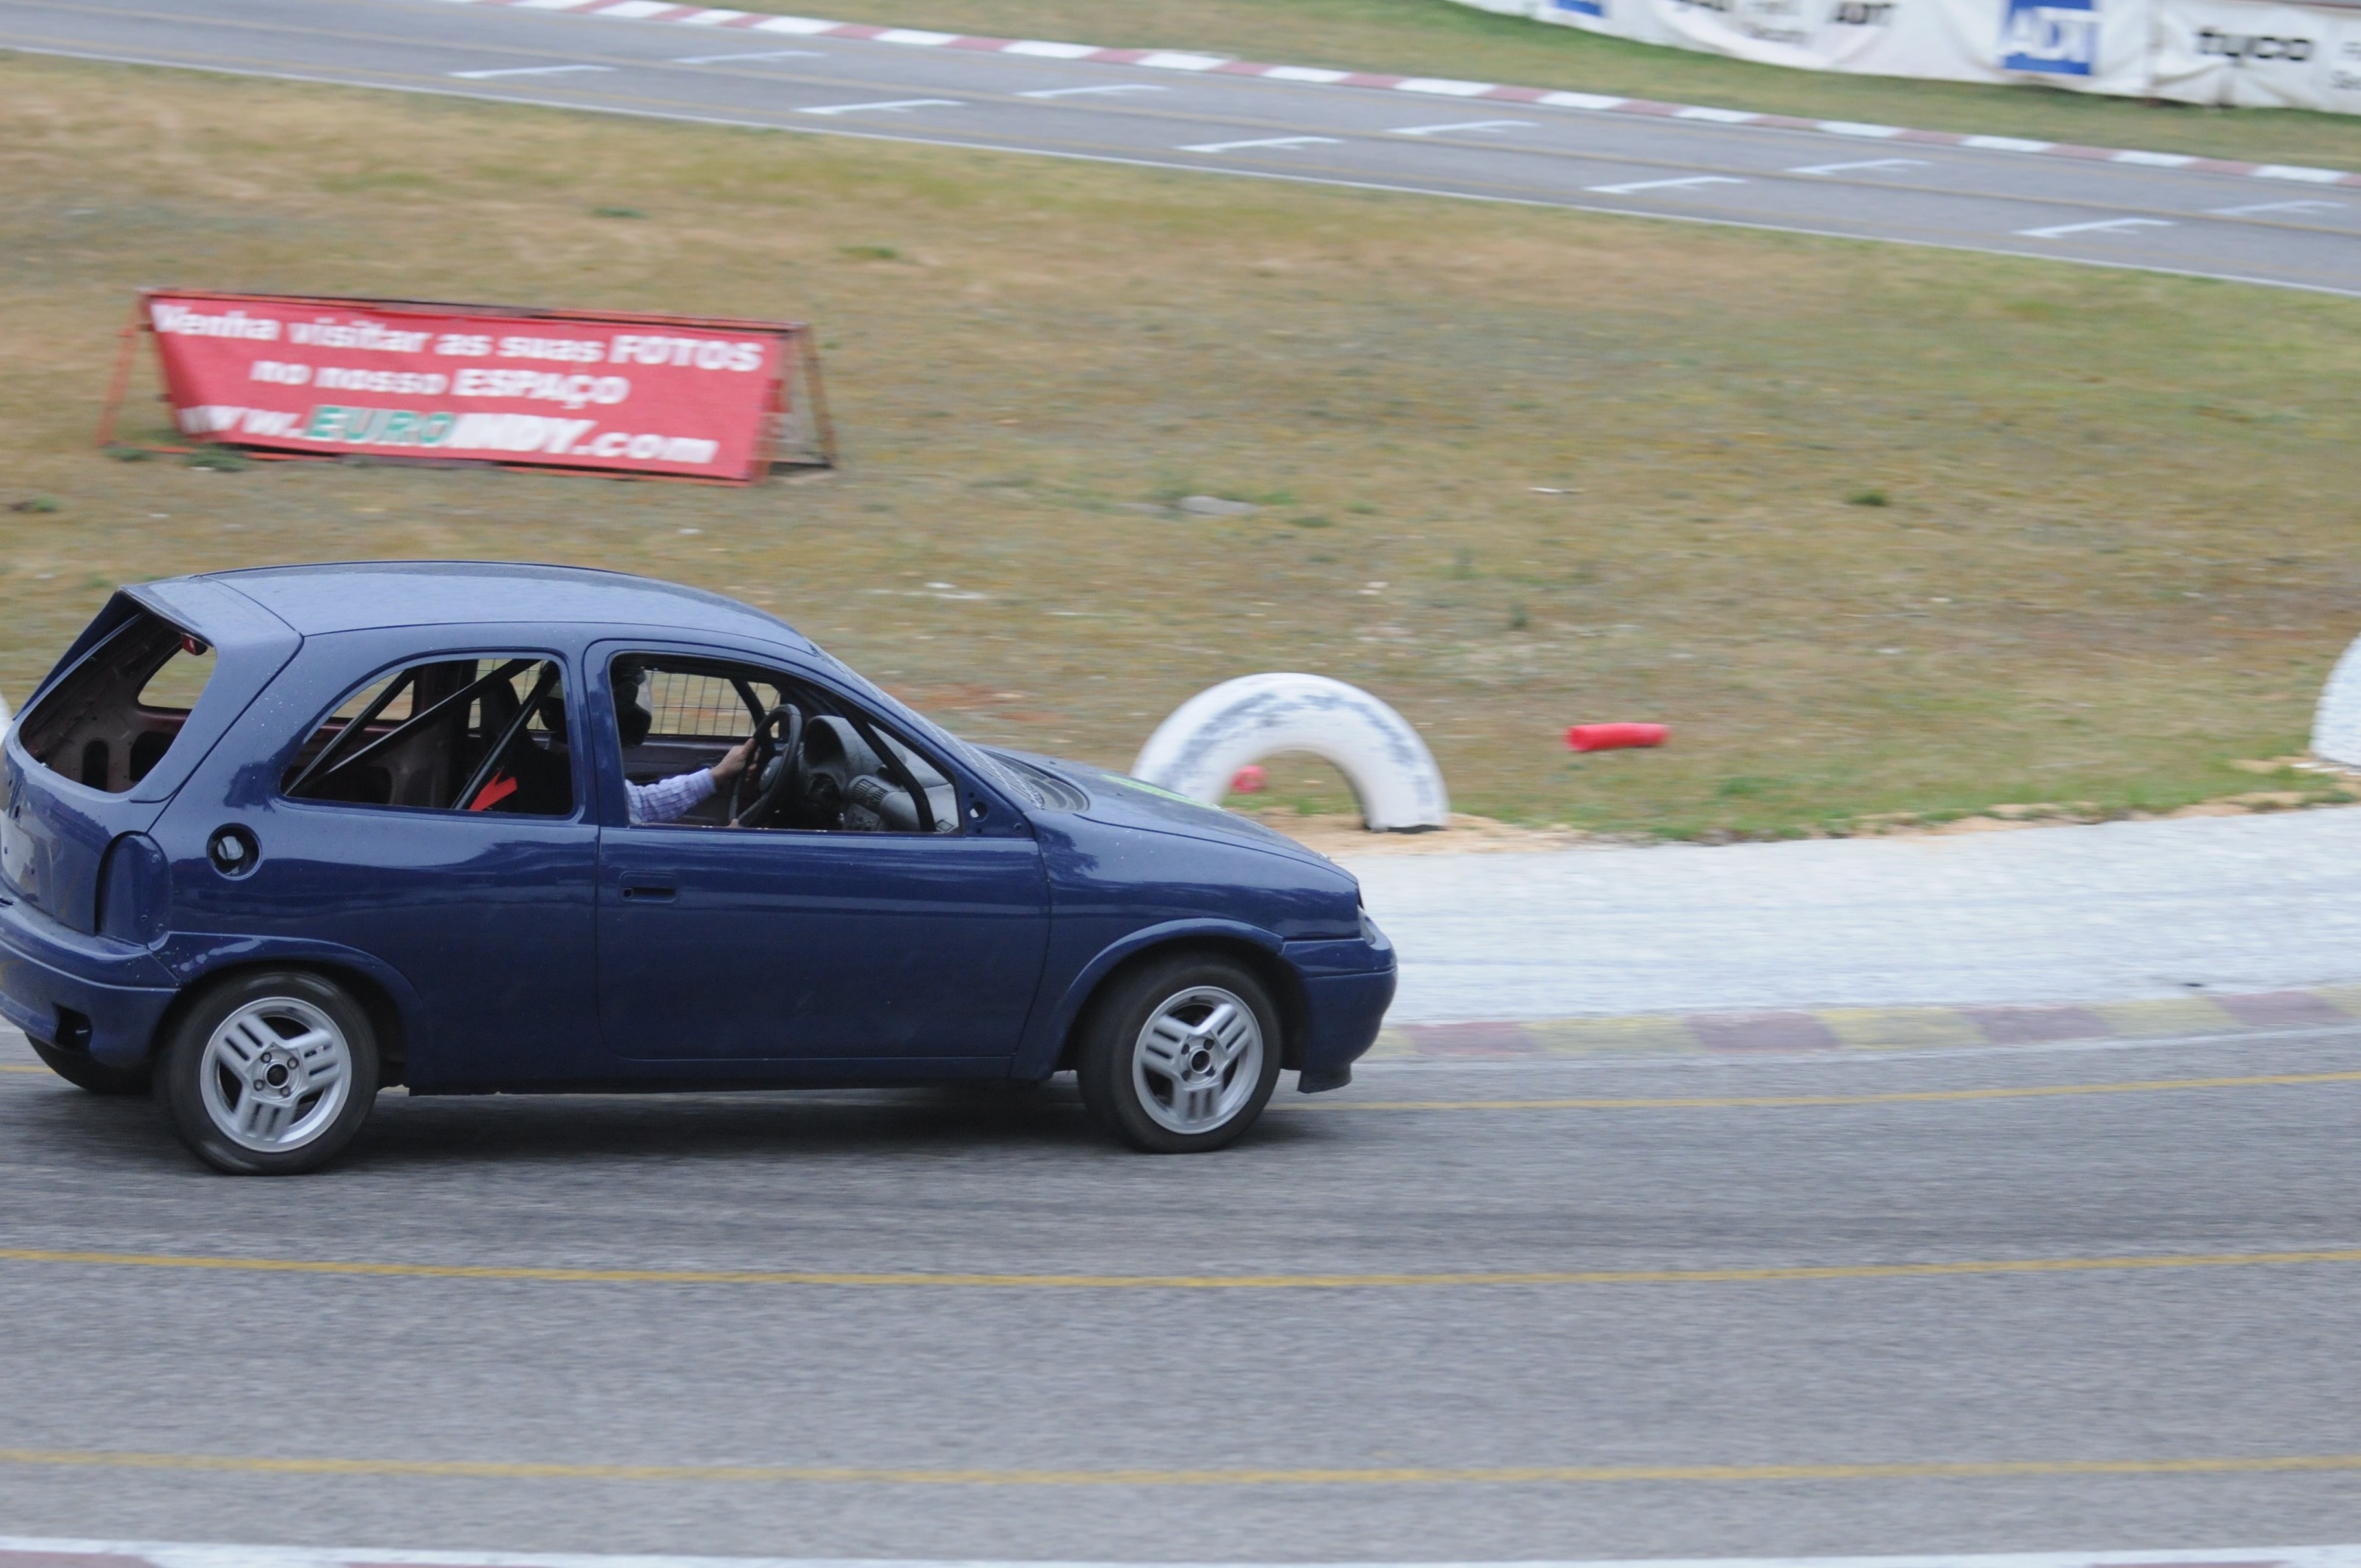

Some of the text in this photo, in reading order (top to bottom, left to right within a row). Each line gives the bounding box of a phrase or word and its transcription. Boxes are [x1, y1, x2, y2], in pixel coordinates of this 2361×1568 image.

[150, 303, 764, 372] Venha visitar as suas FOTOS
[250, 360, 631, 410] no nosso ESPAÇO
